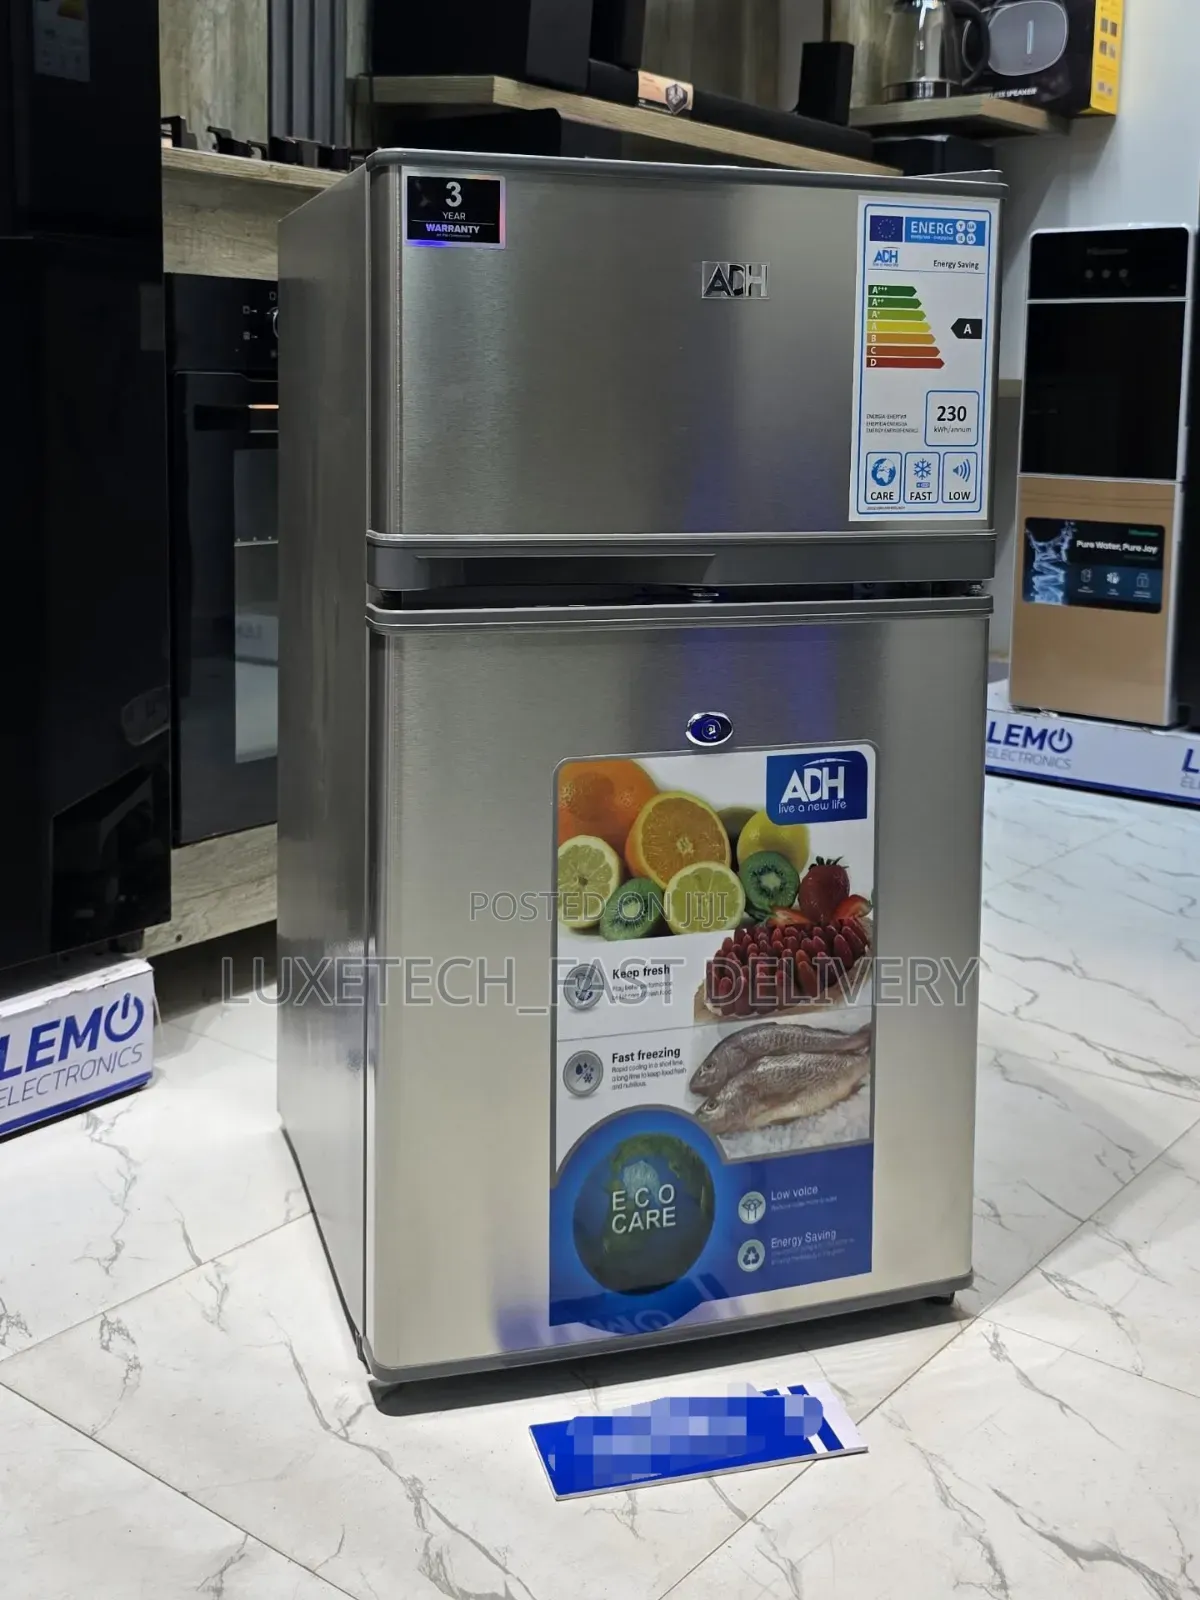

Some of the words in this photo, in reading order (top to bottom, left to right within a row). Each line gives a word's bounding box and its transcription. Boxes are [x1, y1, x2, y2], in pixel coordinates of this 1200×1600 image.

[445, 181, 462, 207] 3
[442, 211, 466, 220] YEAR
[425, 223, 480, 234] WARRANTY
[911, 221, 954, 234] ENERG
[874, 249, 898, 263] ADH
[933, 260, 956, 269] Energy
[957, 261, 979, 270] Saving
[703, 263, 768, 297] ADH
[872, 286, 888, 294] A+++
[871, 298, 884, 306] A++
[963, 323, 972, 334] A
[871, 334, 877, 342] B
[870, 346, 877, 354] C
[936, 405, 967, 422] 230
[870, 491, 894, 501] CARE
[910, 491, 932, 501] FAST
[948, 491, 971, 501] LOW
[1076, 540, 1095, 549] Pure
[1122, 543, 1142, 552] Pure
[1142, 545, 1158, 554] Joy
[987, 746, 1072, 770] ELECTRONICS
[780, 766, 845, 804] ADH
[1180, 776, 1200, 790] EL
[778, 803, 795, 814] live
[808, 803, 829, 812] new
[832, 799, 847, 809] life
[612, 968, 640, 980] Keep
[643, 964, 670, 976] fresh
[612, 1052, 635, 1064] Fast
[638, 1047, 681, 1060] freezing
[771, 1190, 790, 1201] Low
[793, 1186, 819, 1197] voice
[611, 1206, 677, 1234] CARE
[771, 1236, 803, 1249] Energy
[805, 1230, 836, 1243] Saving
